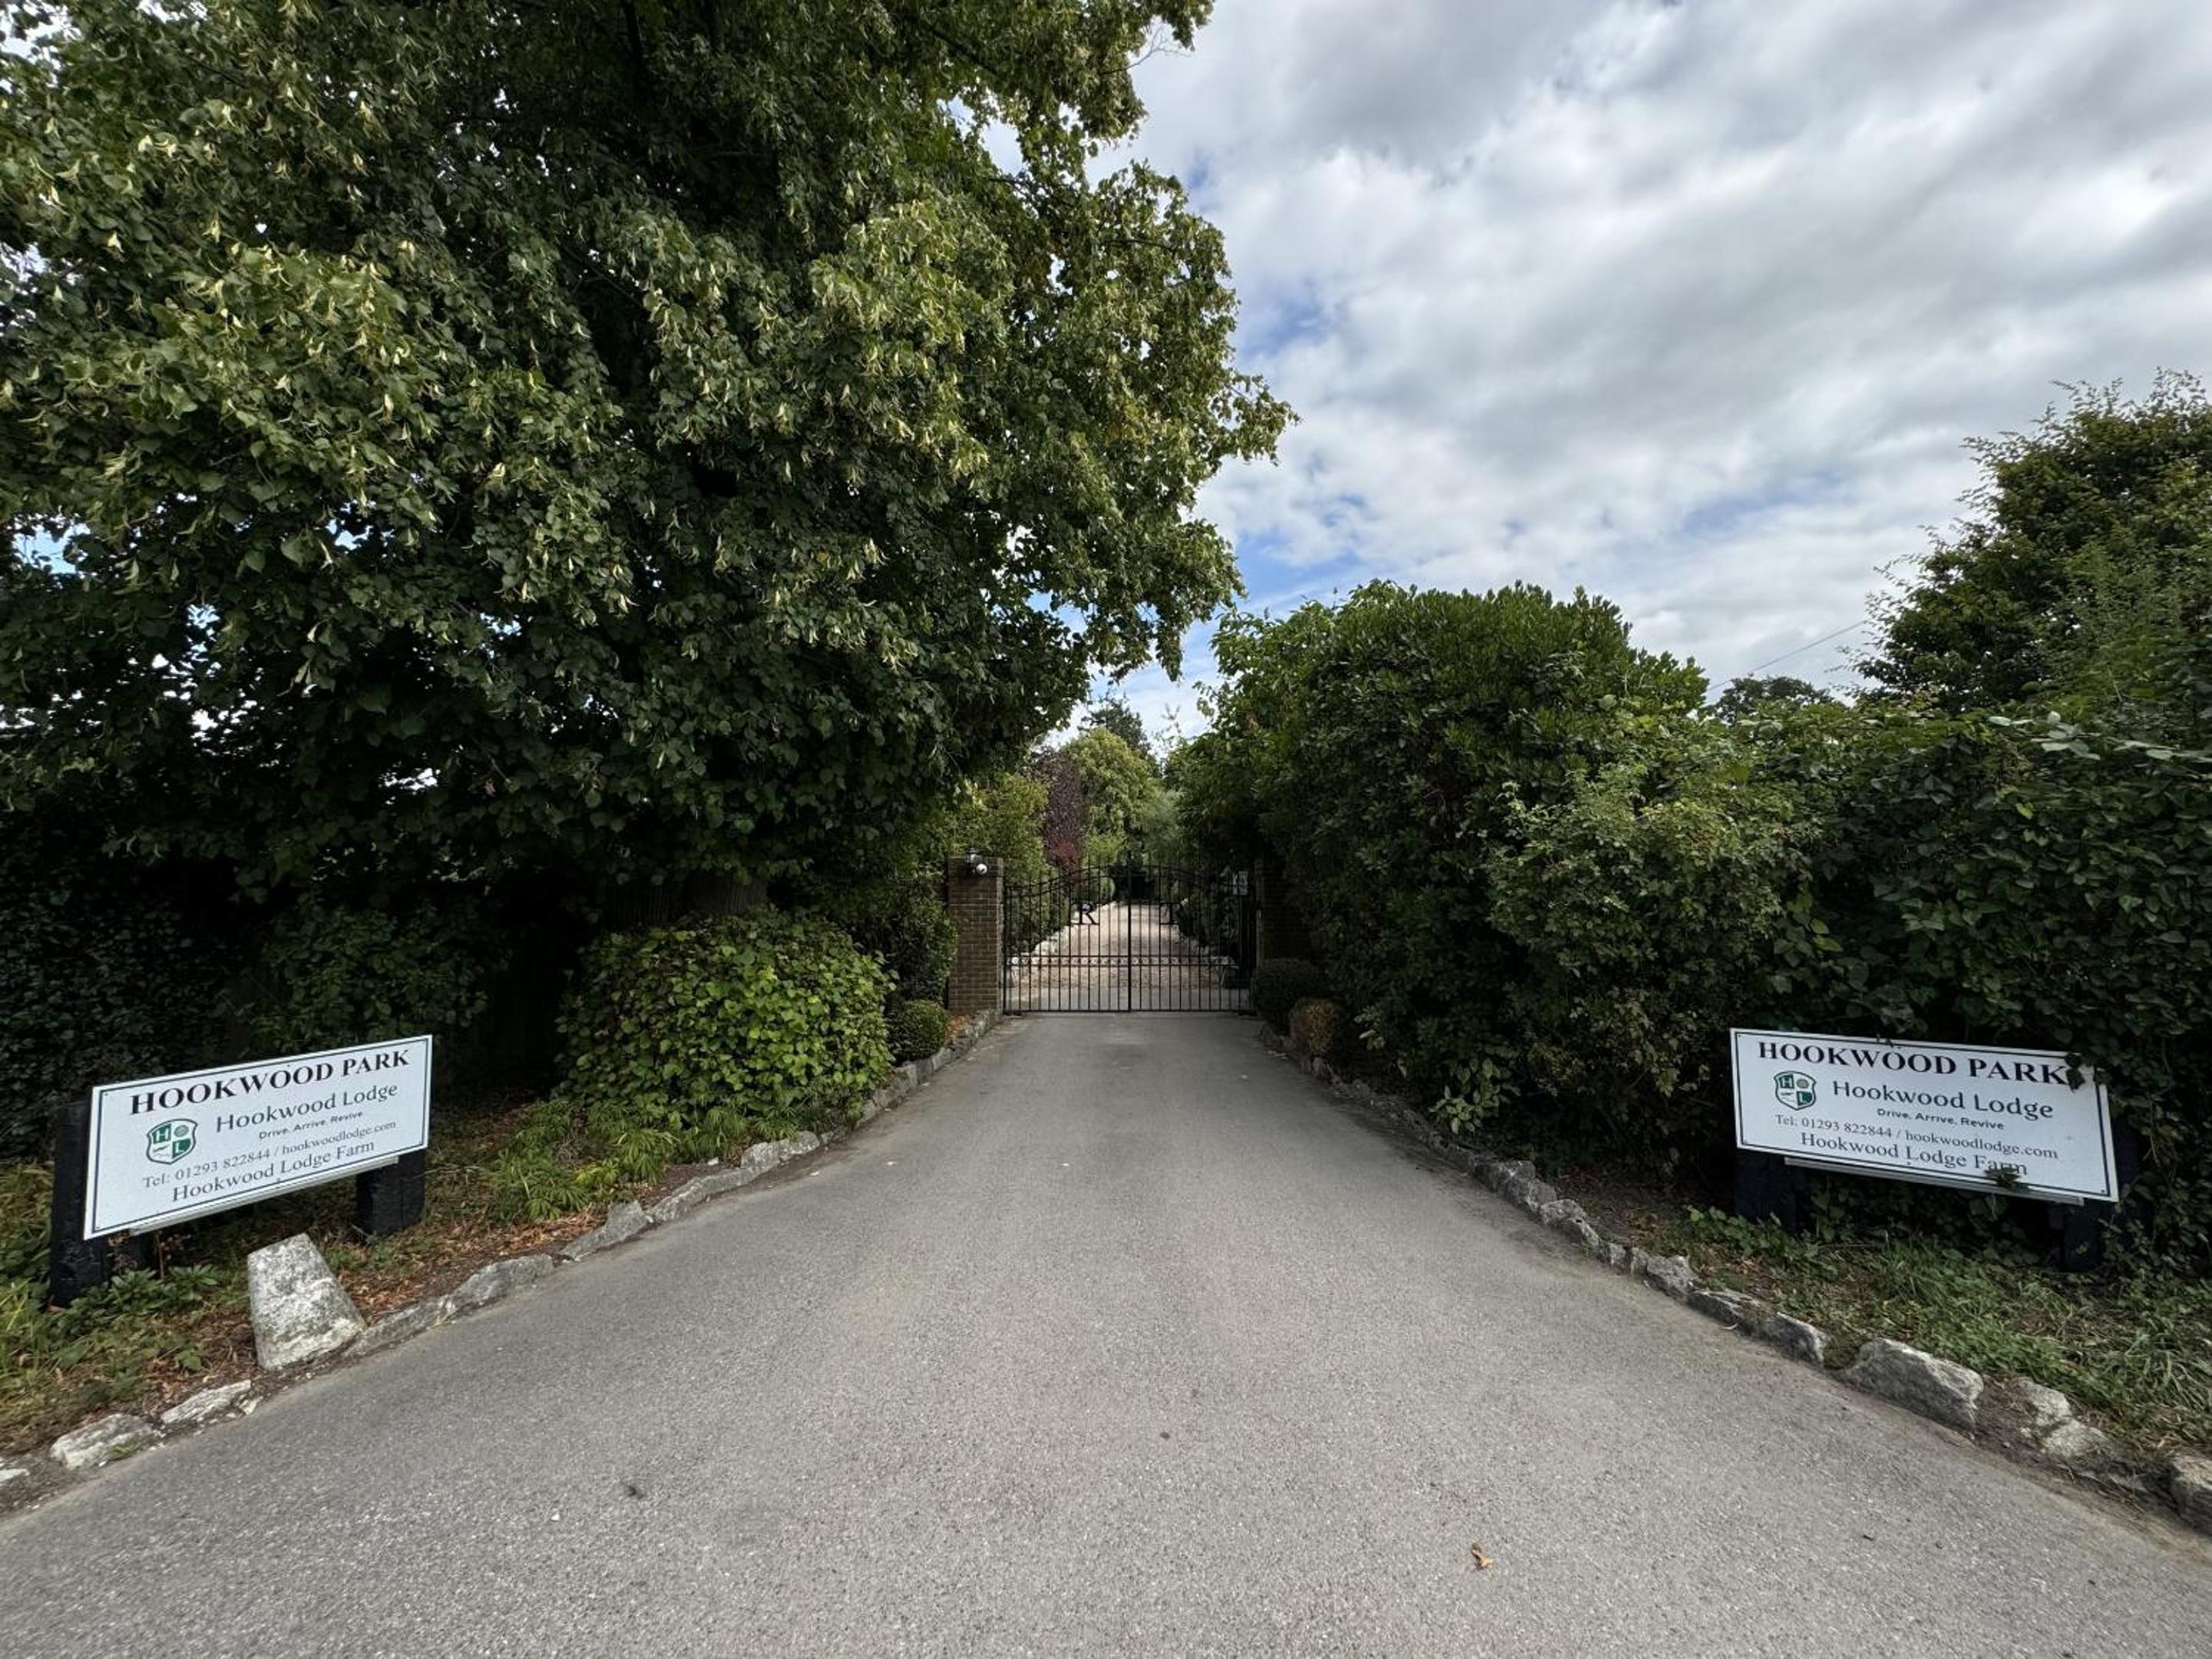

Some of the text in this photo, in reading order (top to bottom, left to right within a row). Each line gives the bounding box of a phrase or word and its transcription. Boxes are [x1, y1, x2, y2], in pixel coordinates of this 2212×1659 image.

[129, 1049, 411, 1115] HOOKWOOD PARK
[1758, 1040, 2069, 1086] HOOKWOOD PARK
[1781, 1076, 1793, 1089] H
[216, 1084, 398, 1133] Hookwood Lodge
[330, 1111, 363, 1123] Revive
[1833, 1080, 2054, 1121] Hookwood Lodge
[155, 1128, 170, 1142] H
[1774, 1114, 2058, 1158] Tel: 01293 822844 / hookwoodlodge.com
[1960, 1117, 2005, 1130] Revive
[143, 1121, 396, 1188] Tel: 01293 822844 / hookwoodlodge.com
[1801, 1132, 1899, 1158] Hookwood
[1906, 1145, 1967, 1168] Lodge
[173, 1142, 375, 1202] Hookwood Lodge Farm
